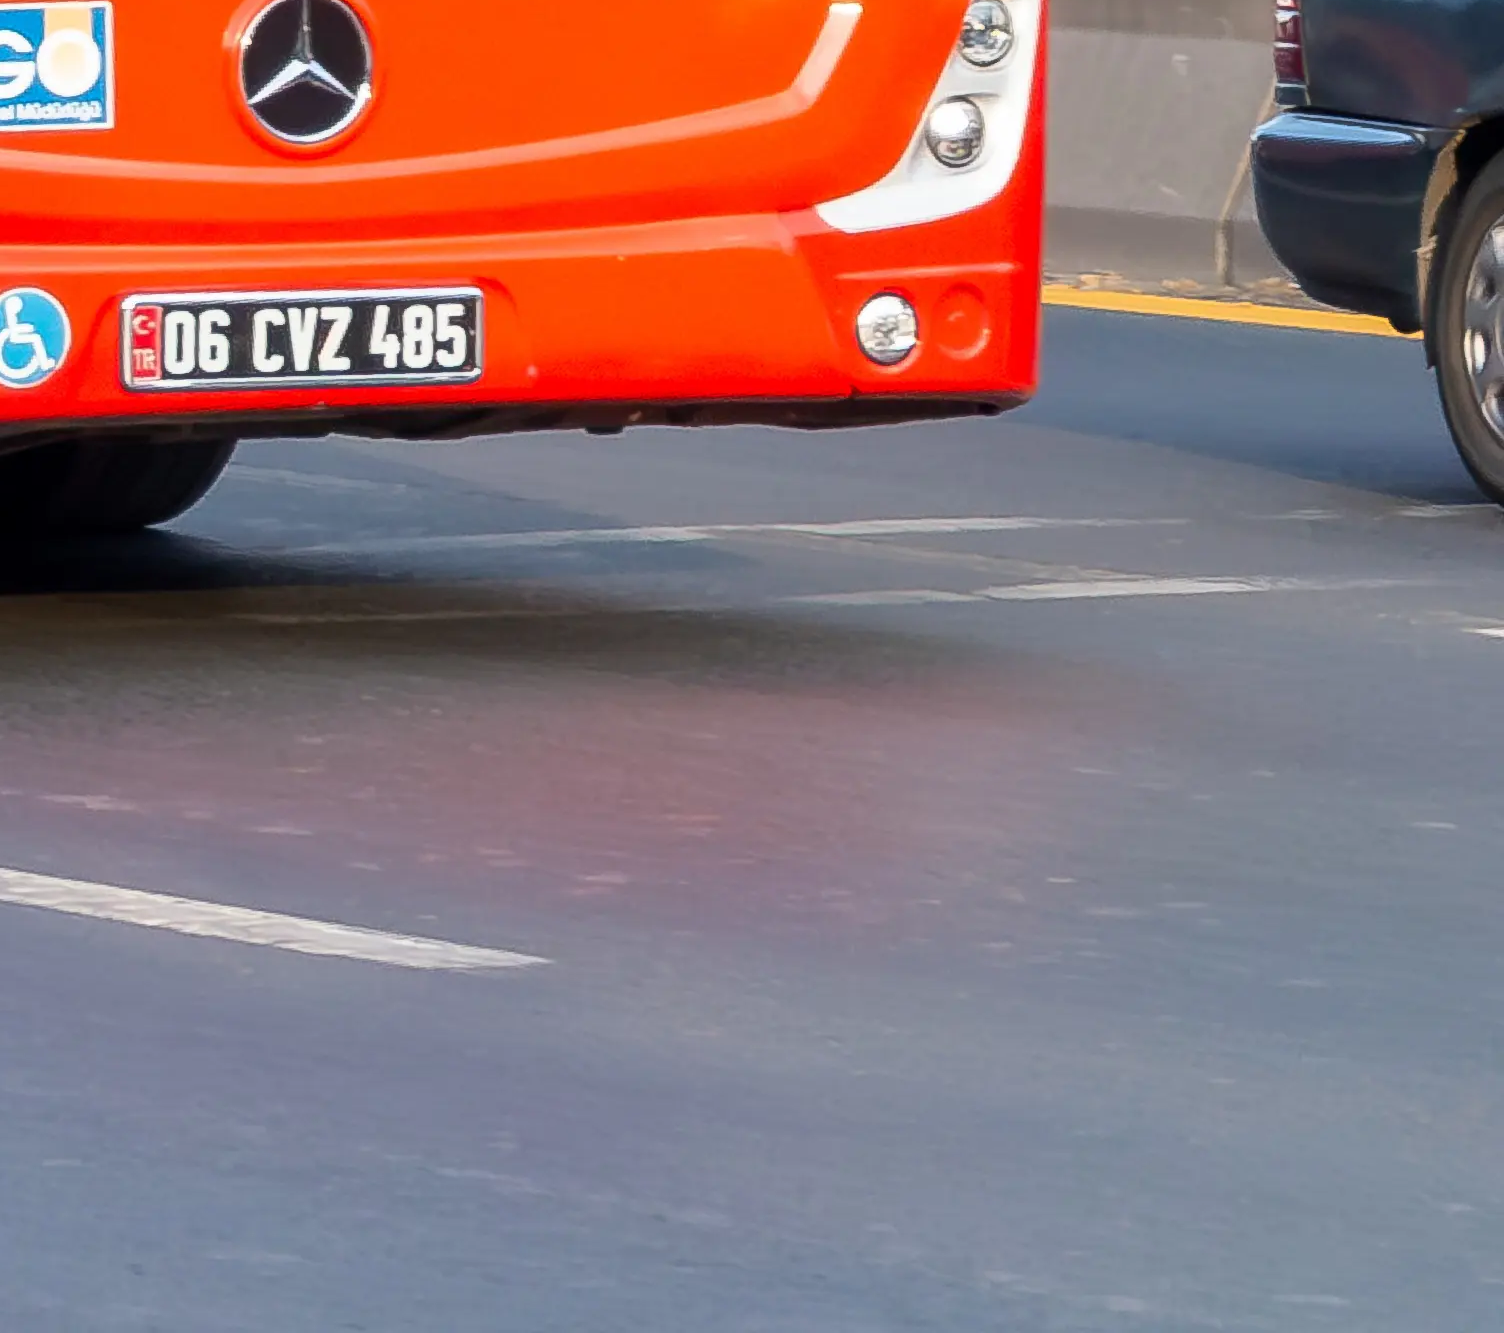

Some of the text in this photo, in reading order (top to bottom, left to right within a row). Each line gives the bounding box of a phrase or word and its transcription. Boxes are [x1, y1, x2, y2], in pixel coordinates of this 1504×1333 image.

[162, 302, 467, 376] 06 CVZ 485
